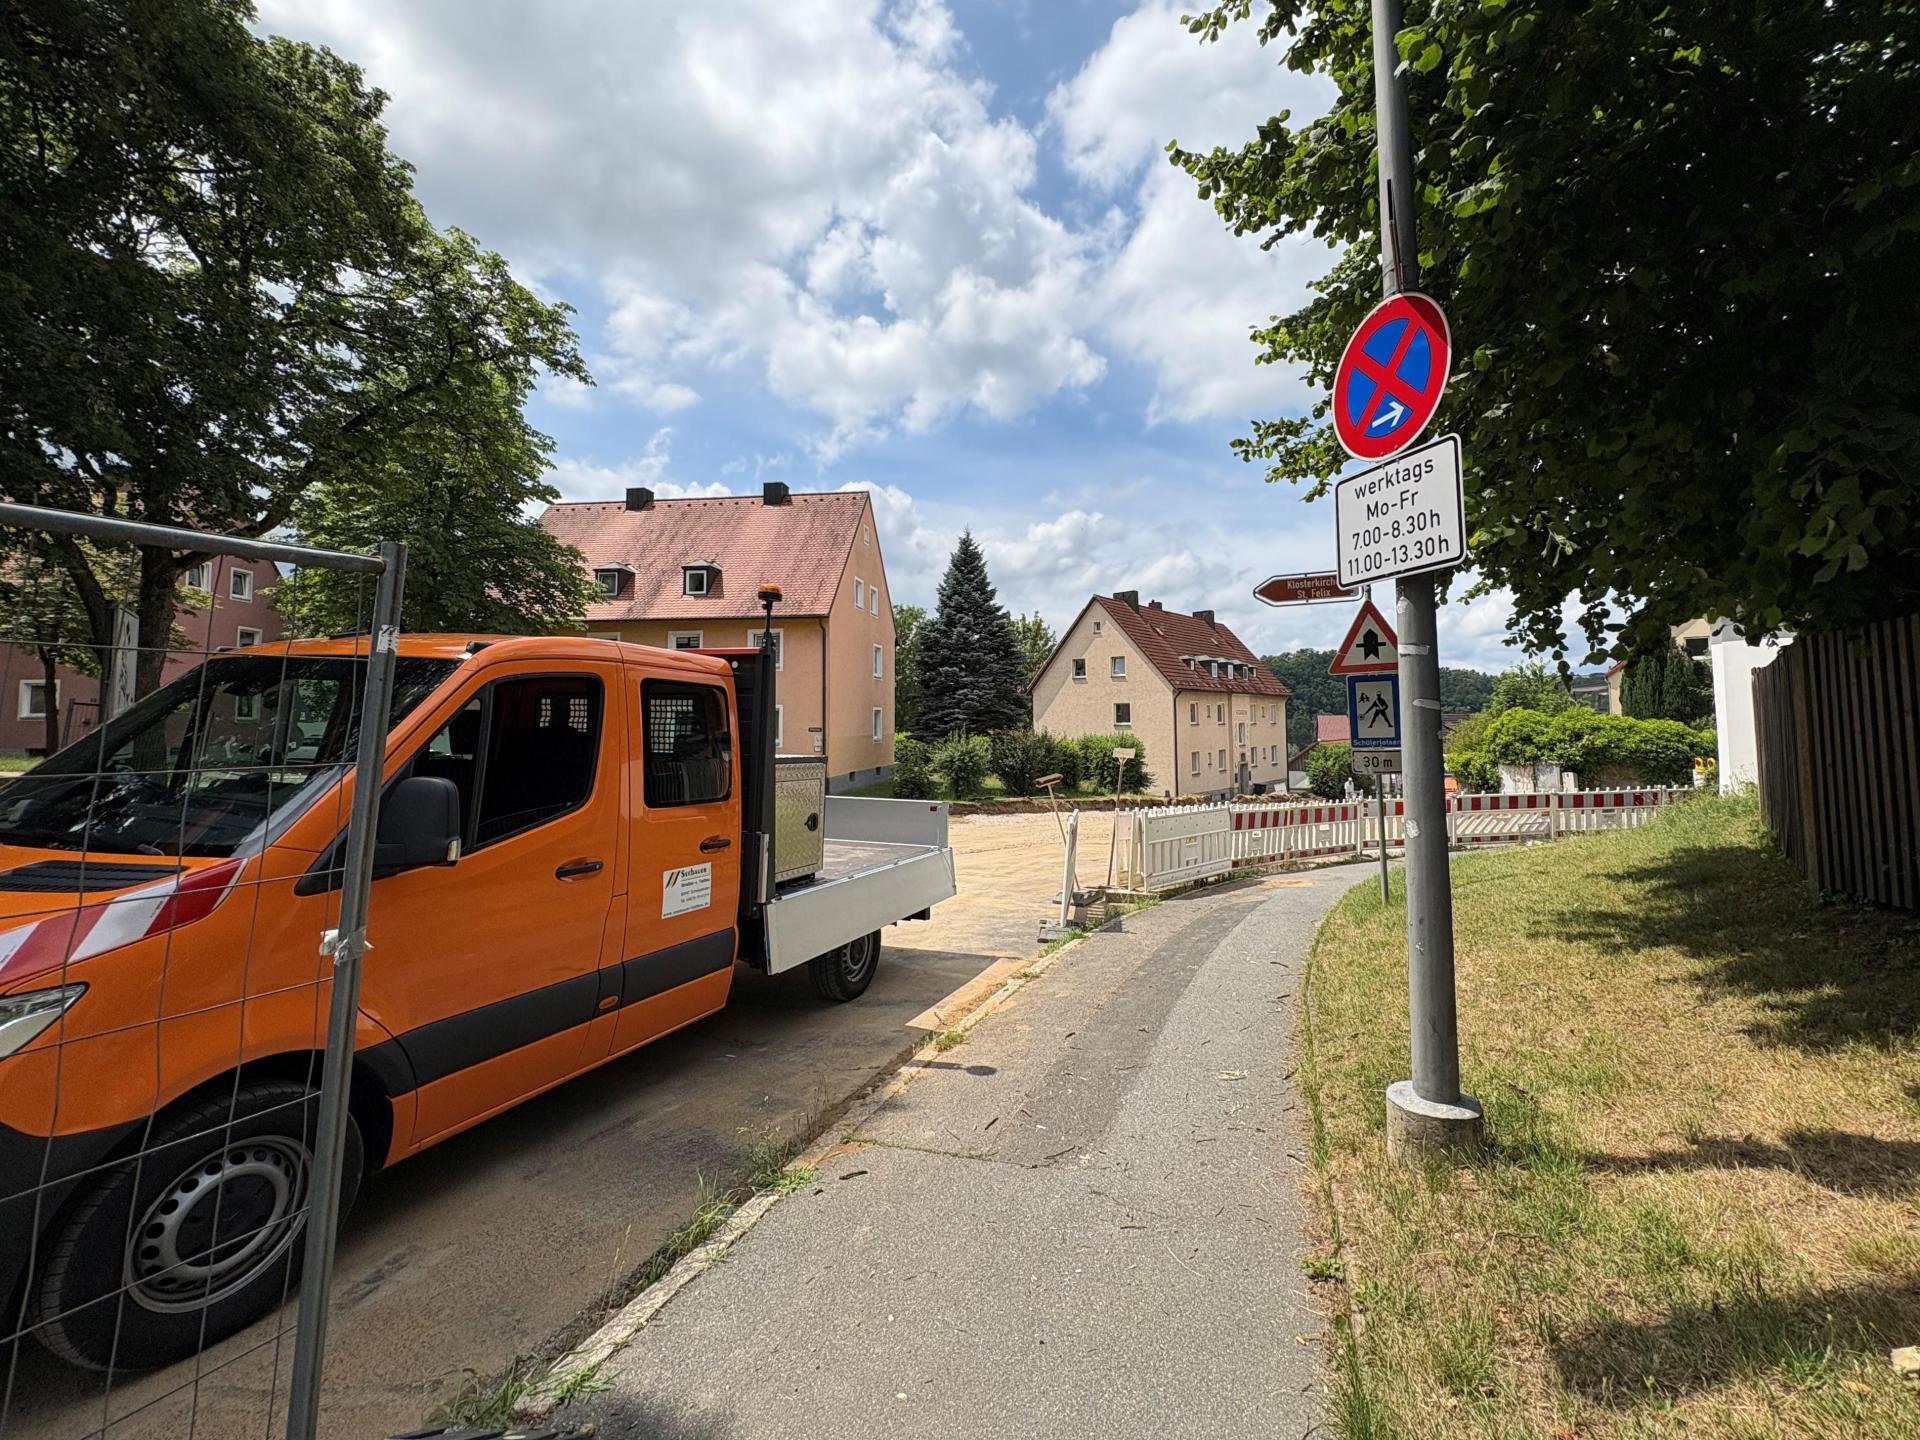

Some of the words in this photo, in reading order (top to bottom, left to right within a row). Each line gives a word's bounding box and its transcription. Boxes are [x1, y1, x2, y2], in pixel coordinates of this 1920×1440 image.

[1354, 459, 1434, 500] werktags
[1366, 489, 1419, 521] Mo-Fr
[1287, 577, 1336, 589] Klosterkirch
[1296, 590, 1308, 599] St.
[1311, 588, 1331, 598] Felix
[1363, 756, 1380, 768] 30
[1383, 759, 1393, 768] m
